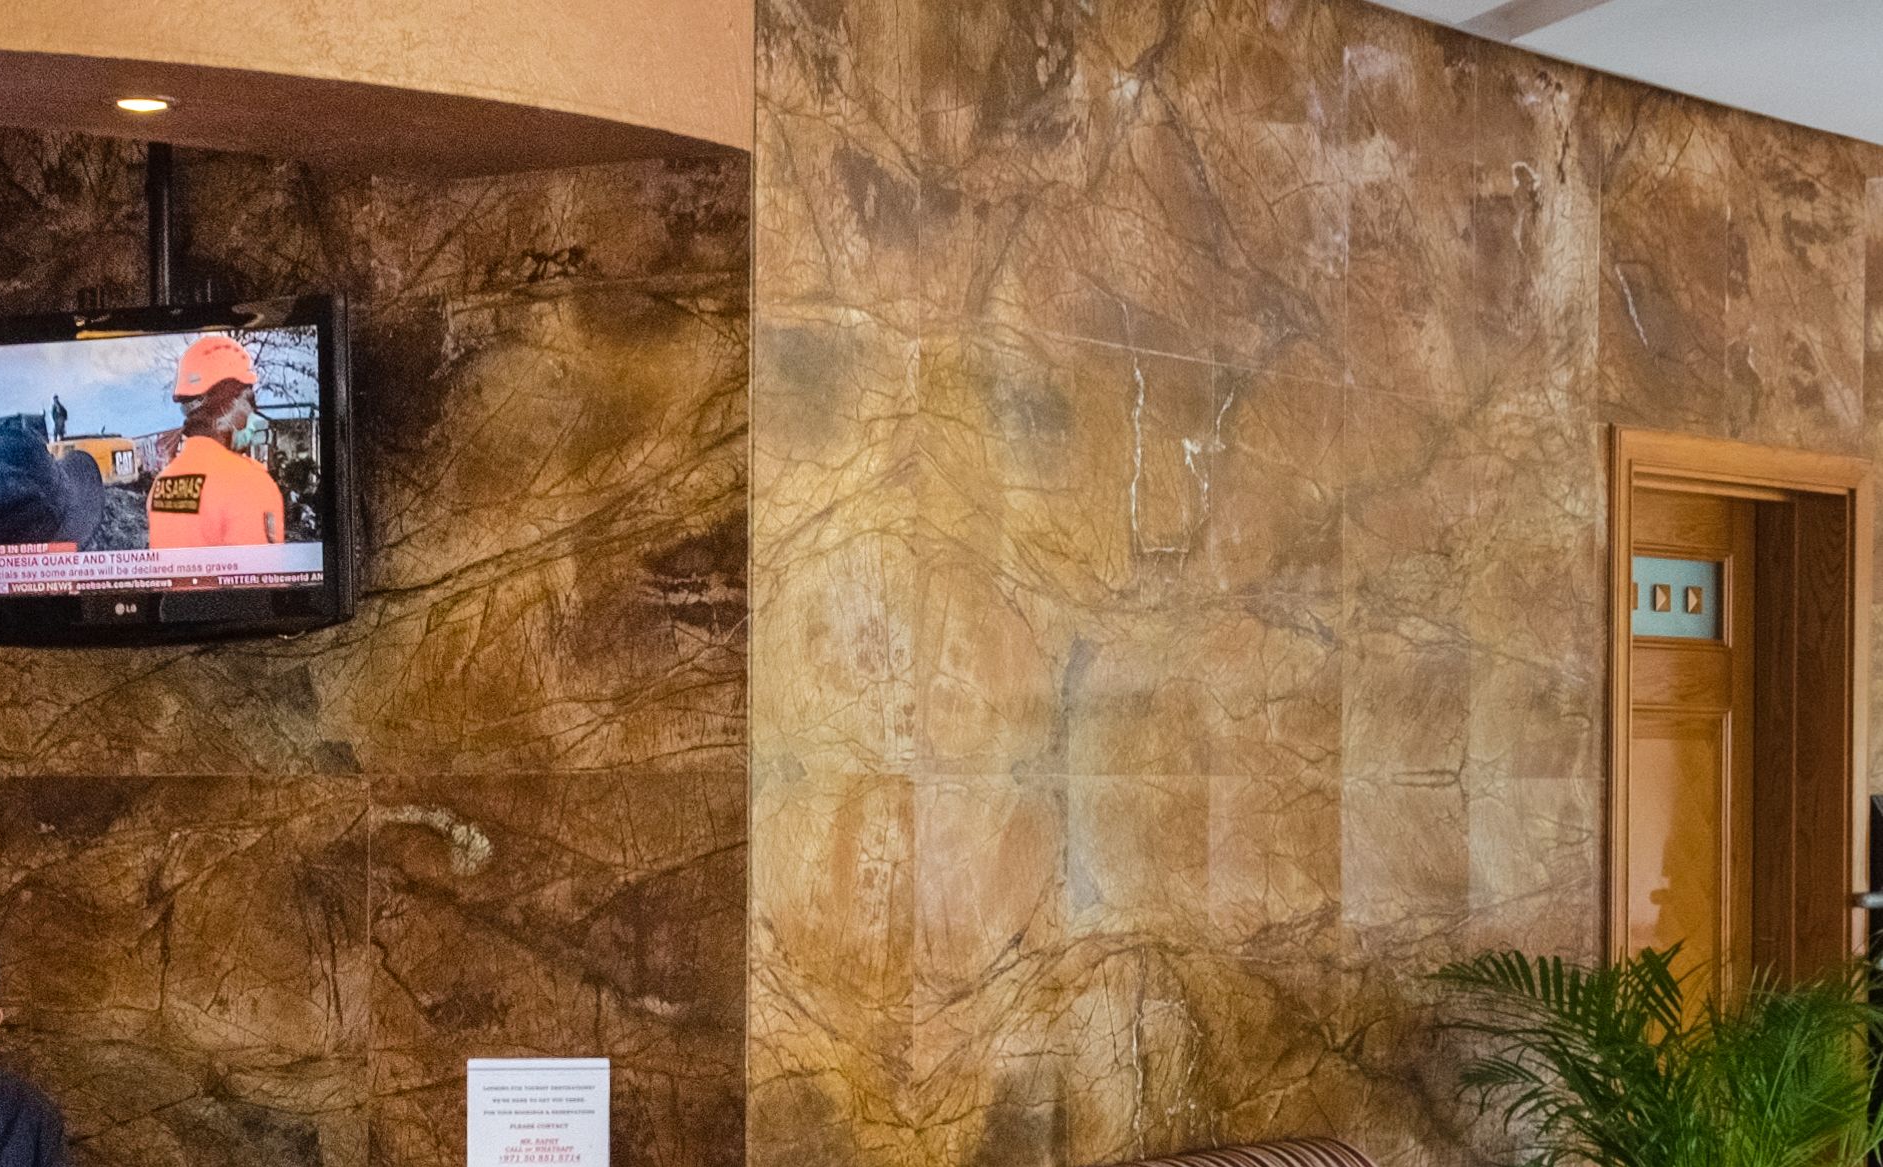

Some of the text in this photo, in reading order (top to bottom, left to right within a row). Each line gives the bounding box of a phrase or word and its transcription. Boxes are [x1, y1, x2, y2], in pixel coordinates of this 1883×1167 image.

[115, 451, 133, 475] CAT
[7, 544, 18, 553] IN
[20, 542, 49, 553] BRIEF
[42, 555, 79, 567] QUAKE
[83, 554, 106, 565] AND
[110, 552, 159, 565] TSUNAMI
[21, 569, 36, 580] say
[40, 569, 66, 578] some
[68, 567, 94, 577] areas
[98, 565, 113, 576] will
[116, 565, 129, 575] be
[131, 562, 173, 575] declared
[176, 563, 203, 574] mass
[205, 562, 238, 574] graves
[11, 582, 45, 593] WORLD
[46, 581, 73, 592] NEWS
